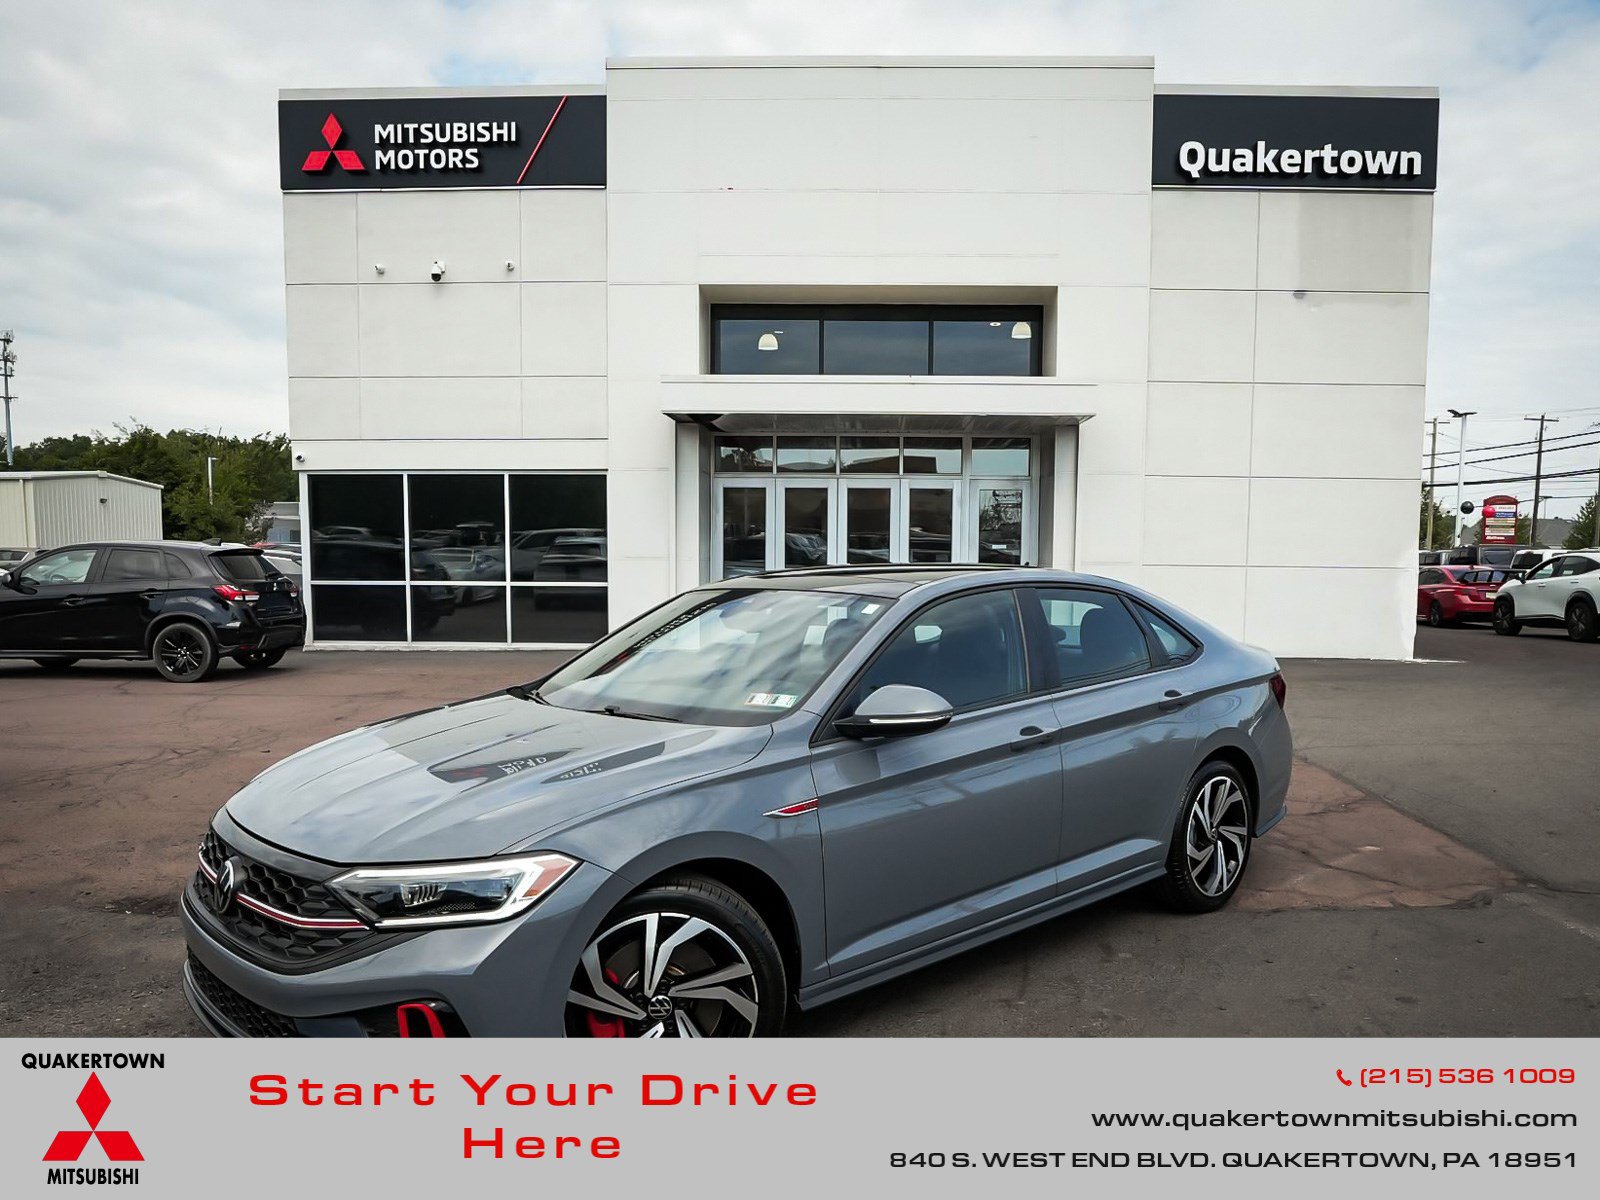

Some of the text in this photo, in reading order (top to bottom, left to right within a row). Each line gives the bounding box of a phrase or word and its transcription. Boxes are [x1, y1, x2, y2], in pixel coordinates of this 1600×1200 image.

[374, 121, 516, 144] MITSUBISHI
[374, 148, 479, 170] MOTORS
[1179, 140, 1422, 178] Quakertown
